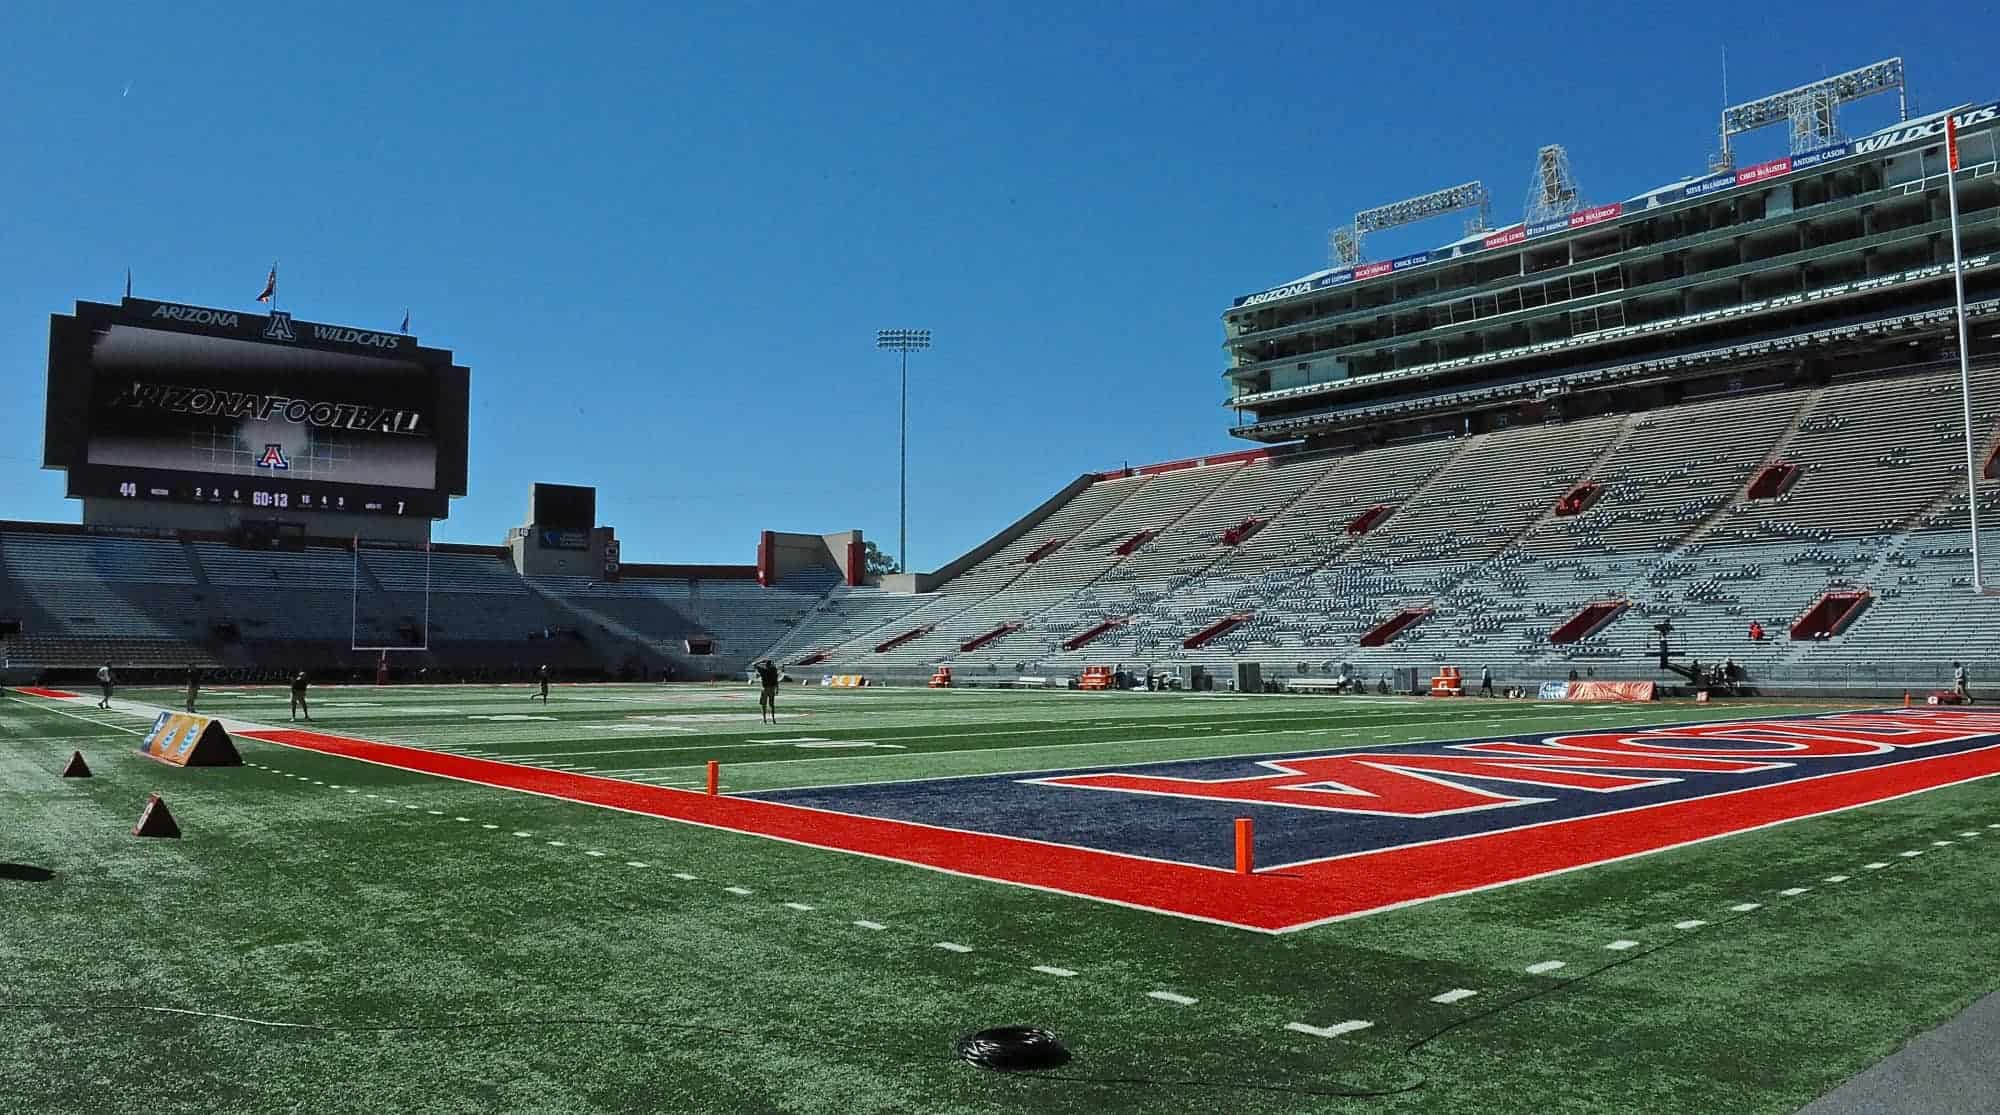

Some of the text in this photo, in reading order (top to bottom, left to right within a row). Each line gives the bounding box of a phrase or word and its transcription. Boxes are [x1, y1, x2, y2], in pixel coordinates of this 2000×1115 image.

[1822, 148, 1846, 161] CASON
[1739, 171, 1757, 181] CHRIS
[1243, 282, 1312, 306] ARIZONA
[152, 304, 239, 328] ARIZONA
[313, 325, 400, 349] WILDCATS
[255, 443, 290, 470] A
[120, 482, 137, 497] 44
[398, 501, 405, 515] 7
